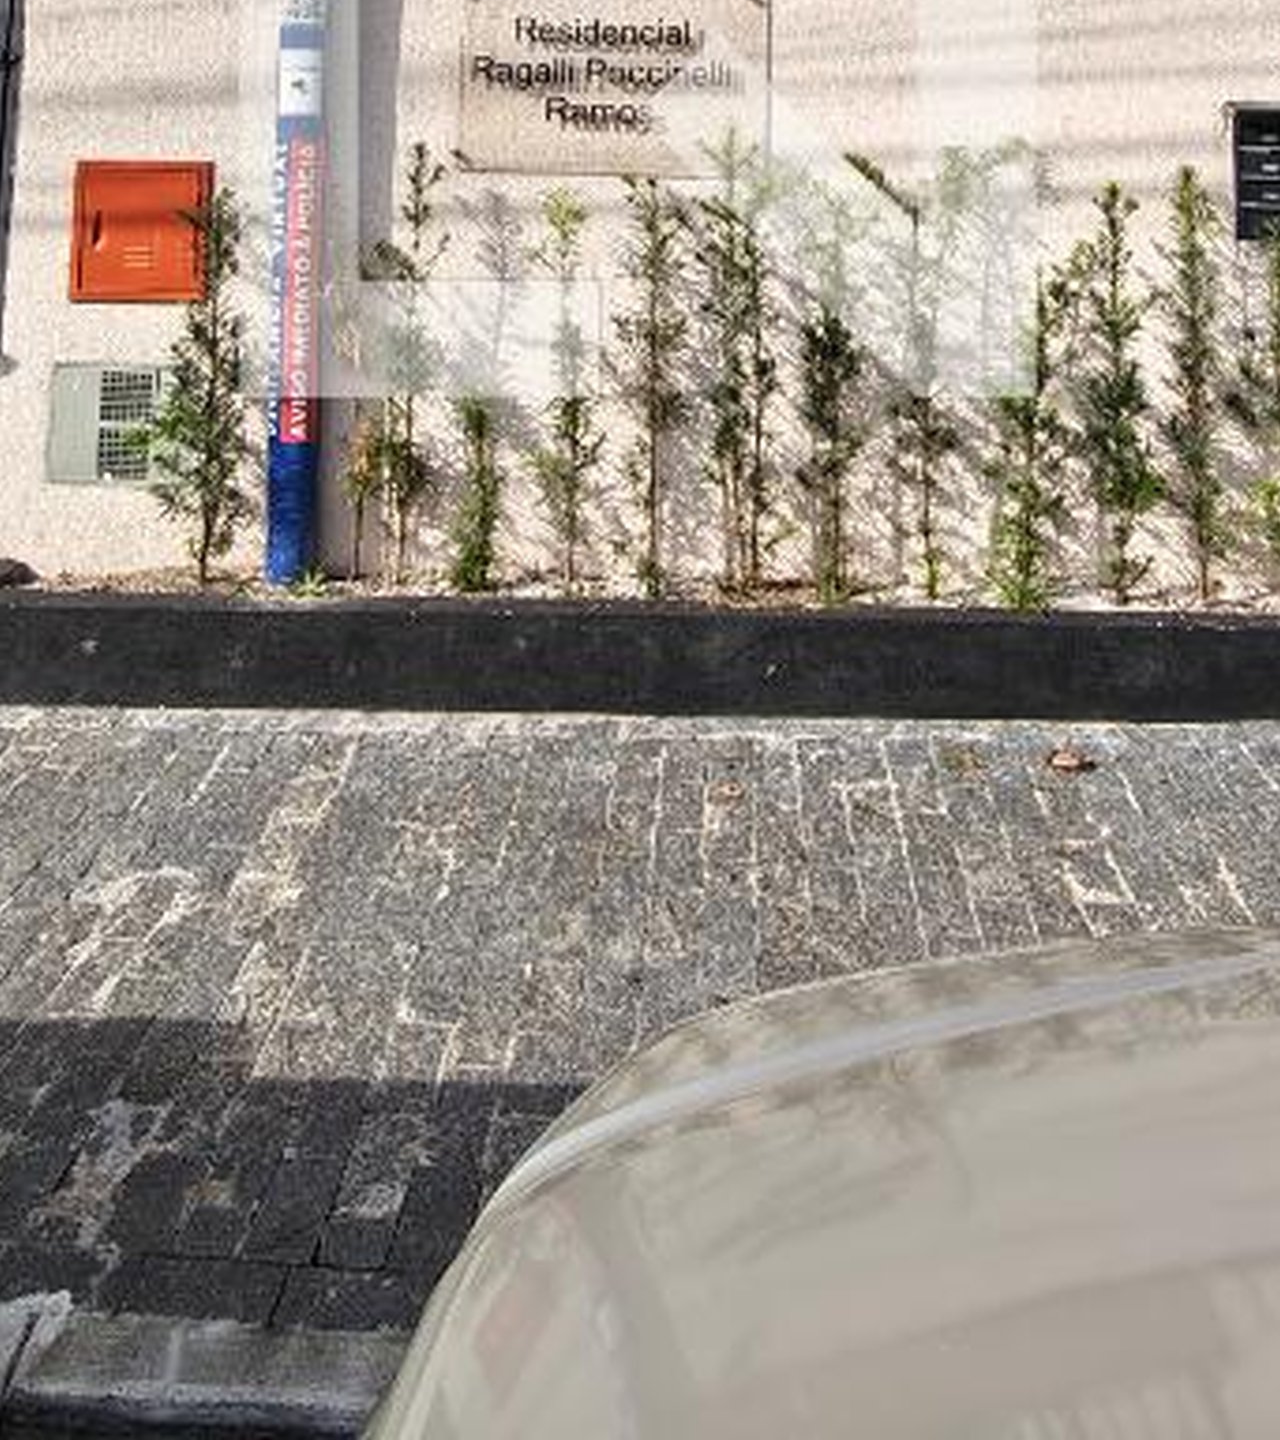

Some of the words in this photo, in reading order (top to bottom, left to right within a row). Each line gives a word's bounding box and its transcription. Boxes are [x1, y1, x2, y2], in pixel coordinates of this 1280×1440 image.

[515, 18, 691, 46] Residencial
[473, 57, 572, 89] Ragalli
[545, 97, 651, 124] Ramos
[291, 256, 311, 364] IMEDIATO
[290, 370, 308, 441] AVISO
